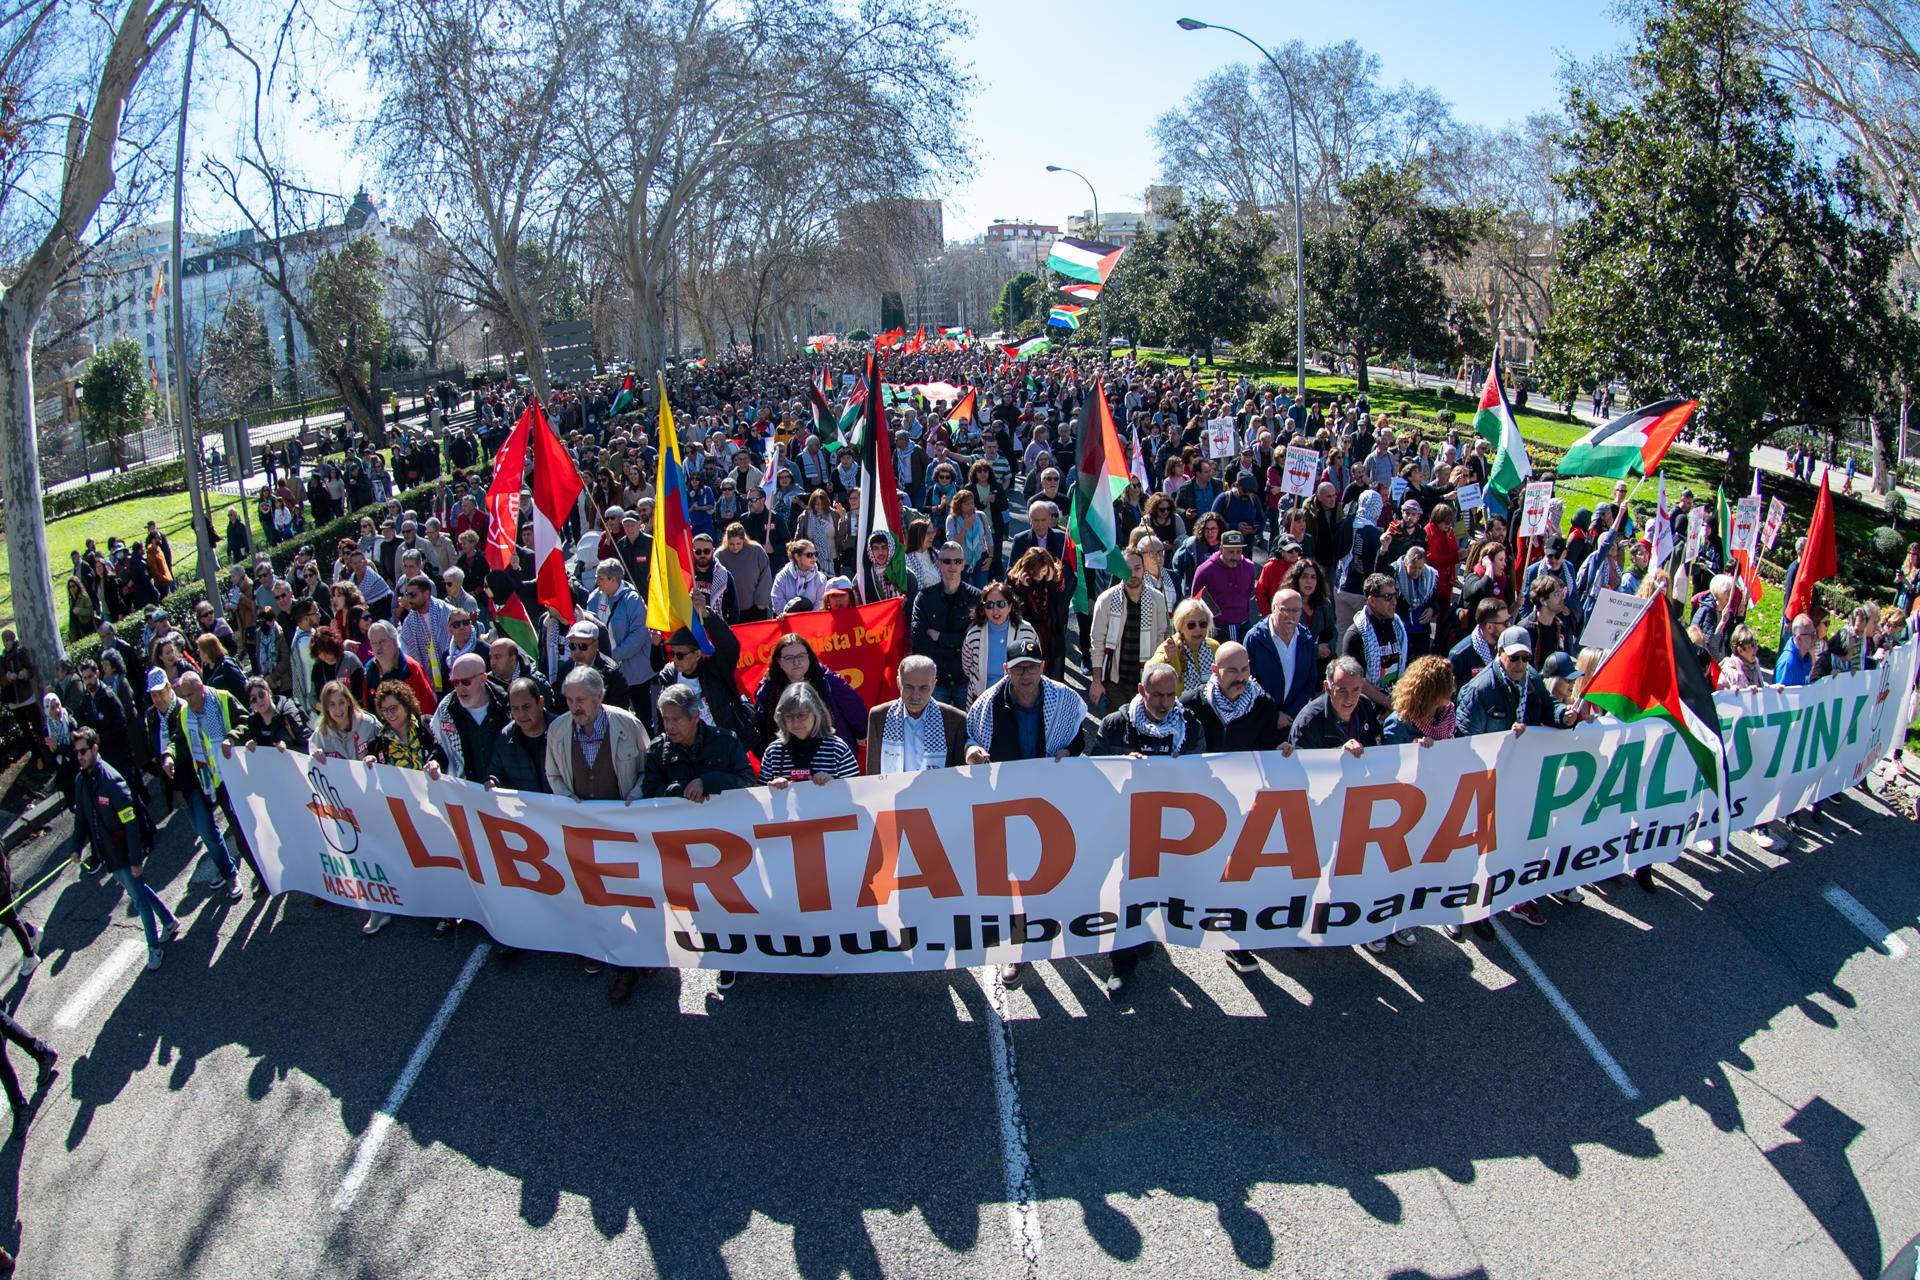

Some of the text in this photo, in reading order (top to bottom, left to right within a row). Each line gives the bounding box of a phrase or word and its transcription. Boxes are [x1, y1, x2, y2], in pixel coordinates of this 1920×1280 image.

[386, 796, 1076, 914] LIBERTAD
[1129, 769, 1497, 882] PARA
[320, 853, 389, 883] FIN A LA
[322, 873, 404, 906] MASACRE
